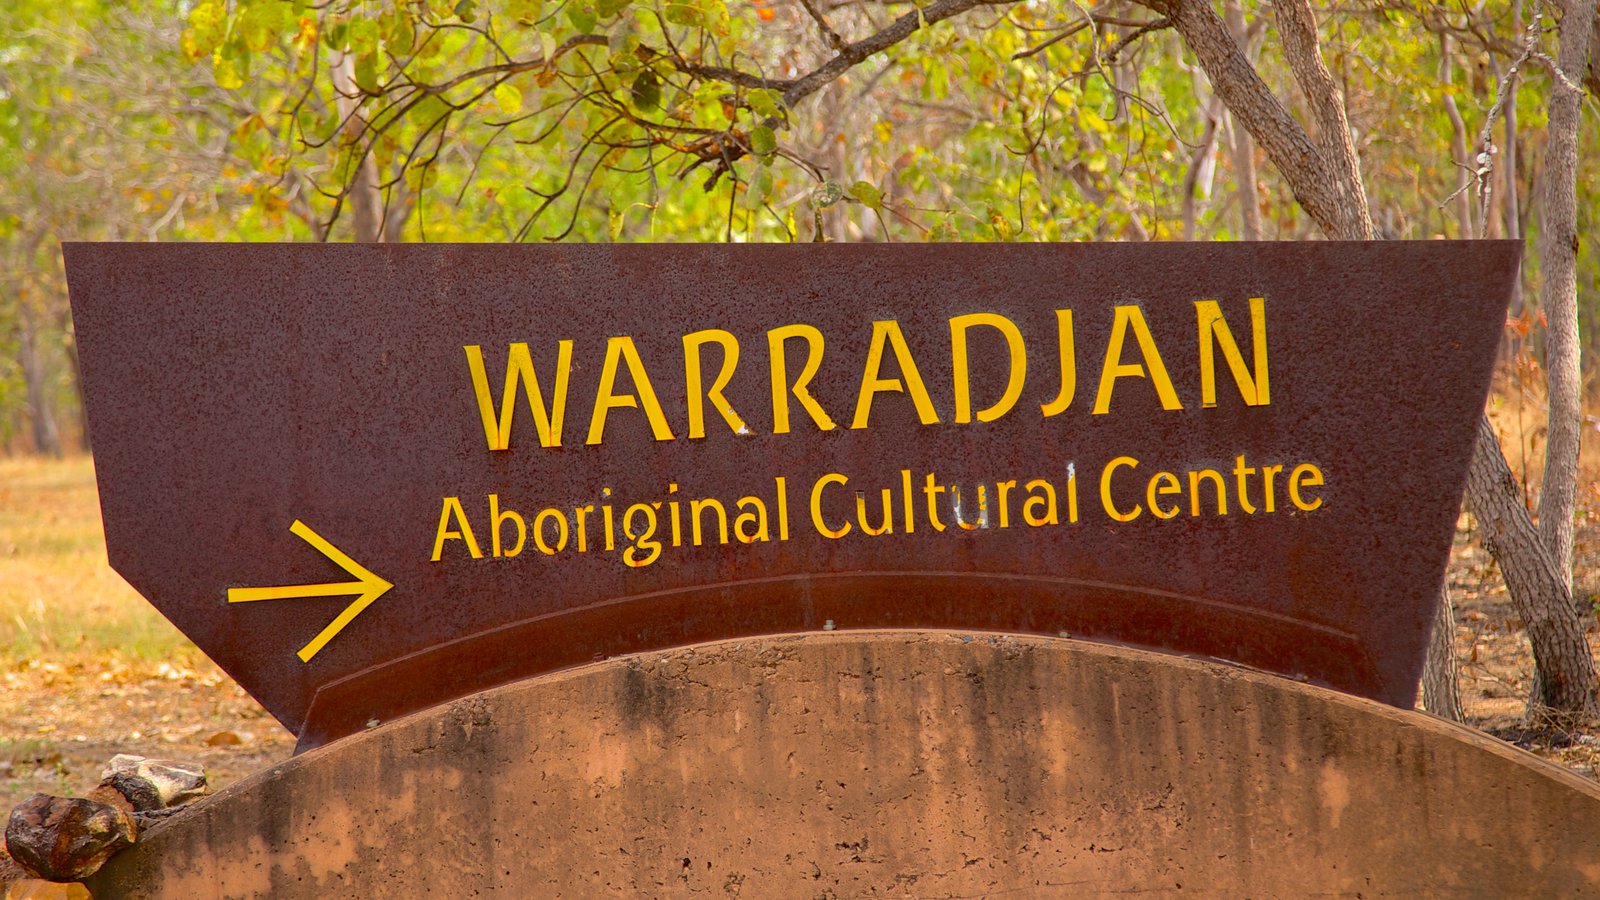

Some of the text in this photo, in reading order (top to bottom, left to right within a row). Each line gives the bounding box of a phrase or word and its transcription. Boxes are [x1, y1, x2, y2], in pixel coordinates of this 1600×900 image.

[463, 297, 1271, 451] WARRADJAN
[430, 454, 1325, 568] Aboriginal Cultural Centre
